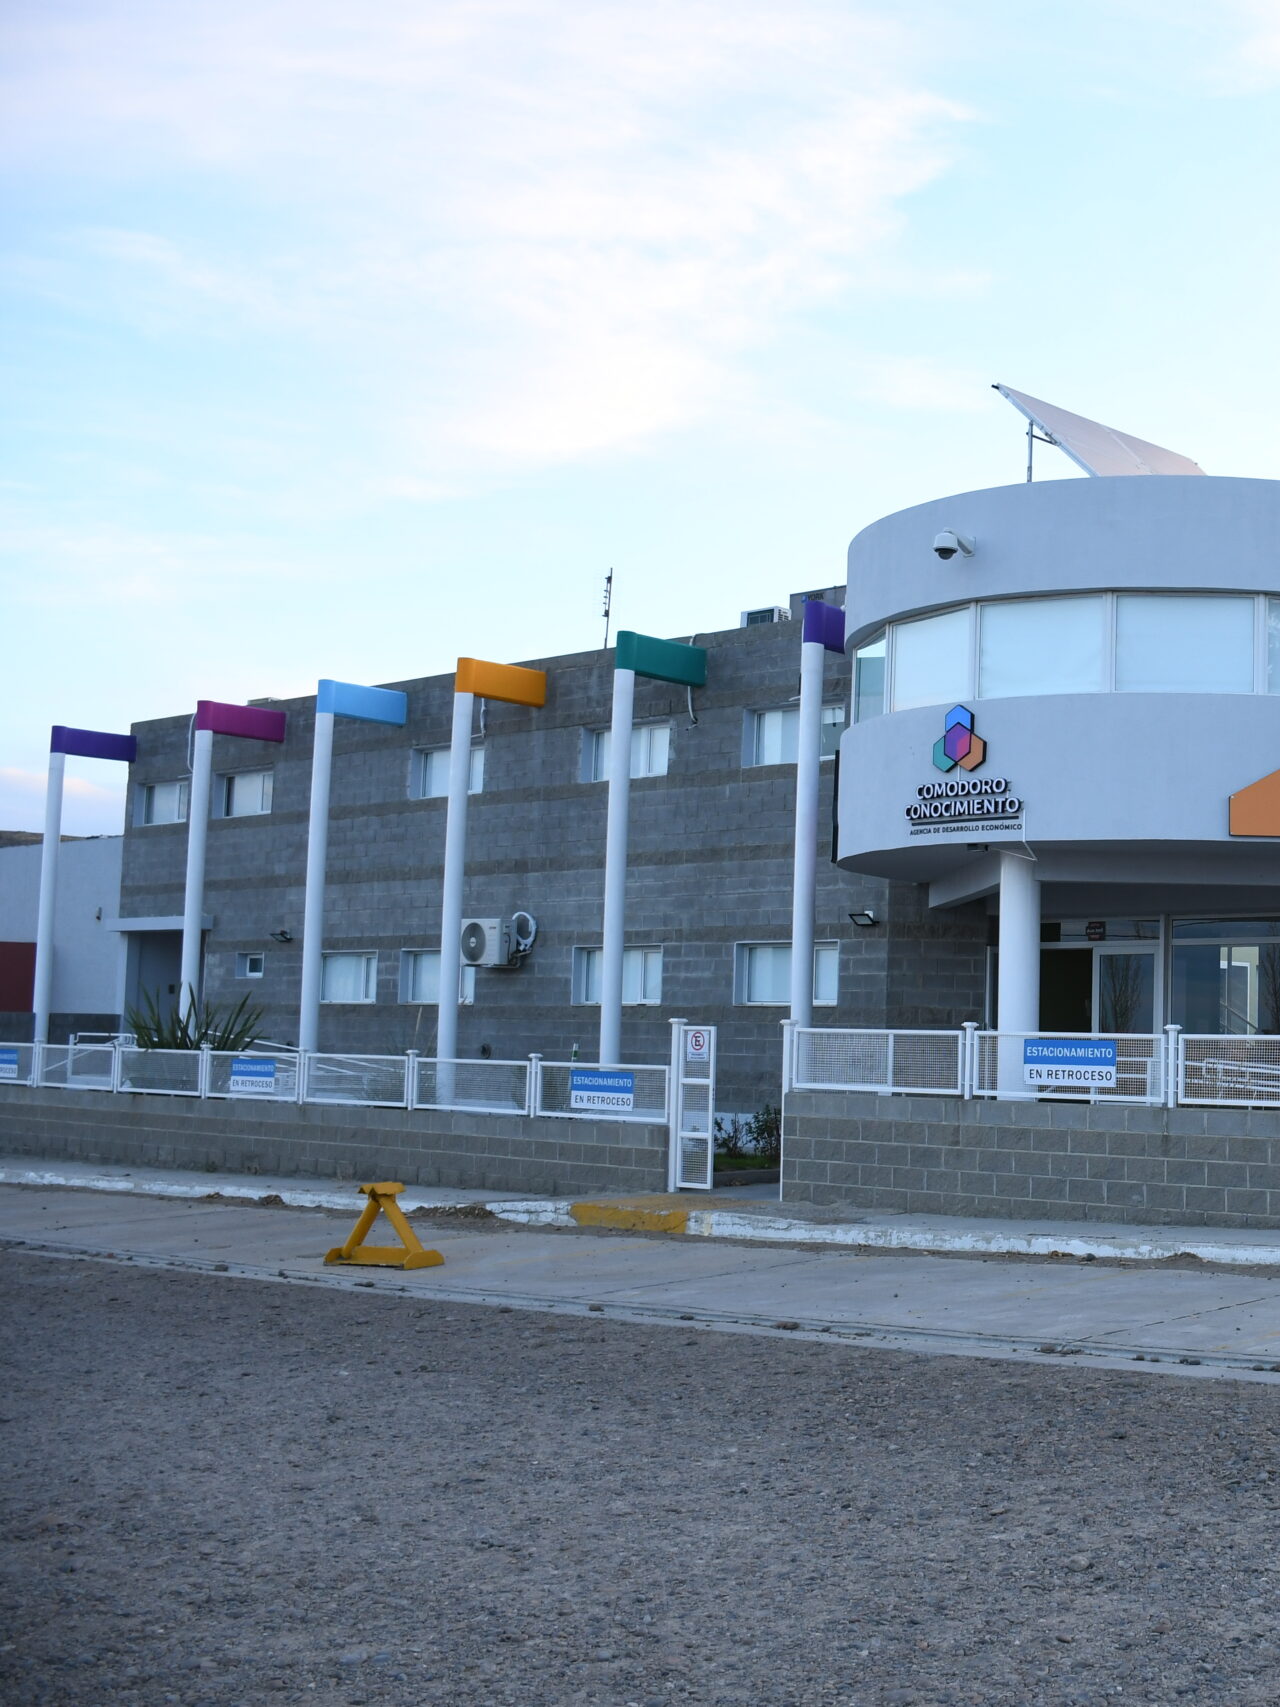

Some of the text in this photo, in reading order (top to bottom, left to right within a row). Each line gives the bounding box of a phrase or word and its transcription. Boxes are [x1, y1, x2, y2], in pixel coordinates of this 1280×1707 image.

[808, 592, 824, 601] YORK
[916, 778, 1008, 800] COMODORO
[904, 797, 1022, 820] CONOCIMIENTO
[909, 828, 932, 836] AGENCIA
[942, 824, 980, 833] DESARROLLO
[981, 822, 1023, 831] ECONÓMICO
[1026, 1046, 1113, 1058] ESTACIONAMIENTO
[1029, 1069, 1113, 1081] EN RETROCESO
[240, 1079, 273, 1089] RETROCESO
[573, 1076, 632, 1087] ESTACIONAMIENTO
[574, 1094, 631, 1107] EN RETROCESO
